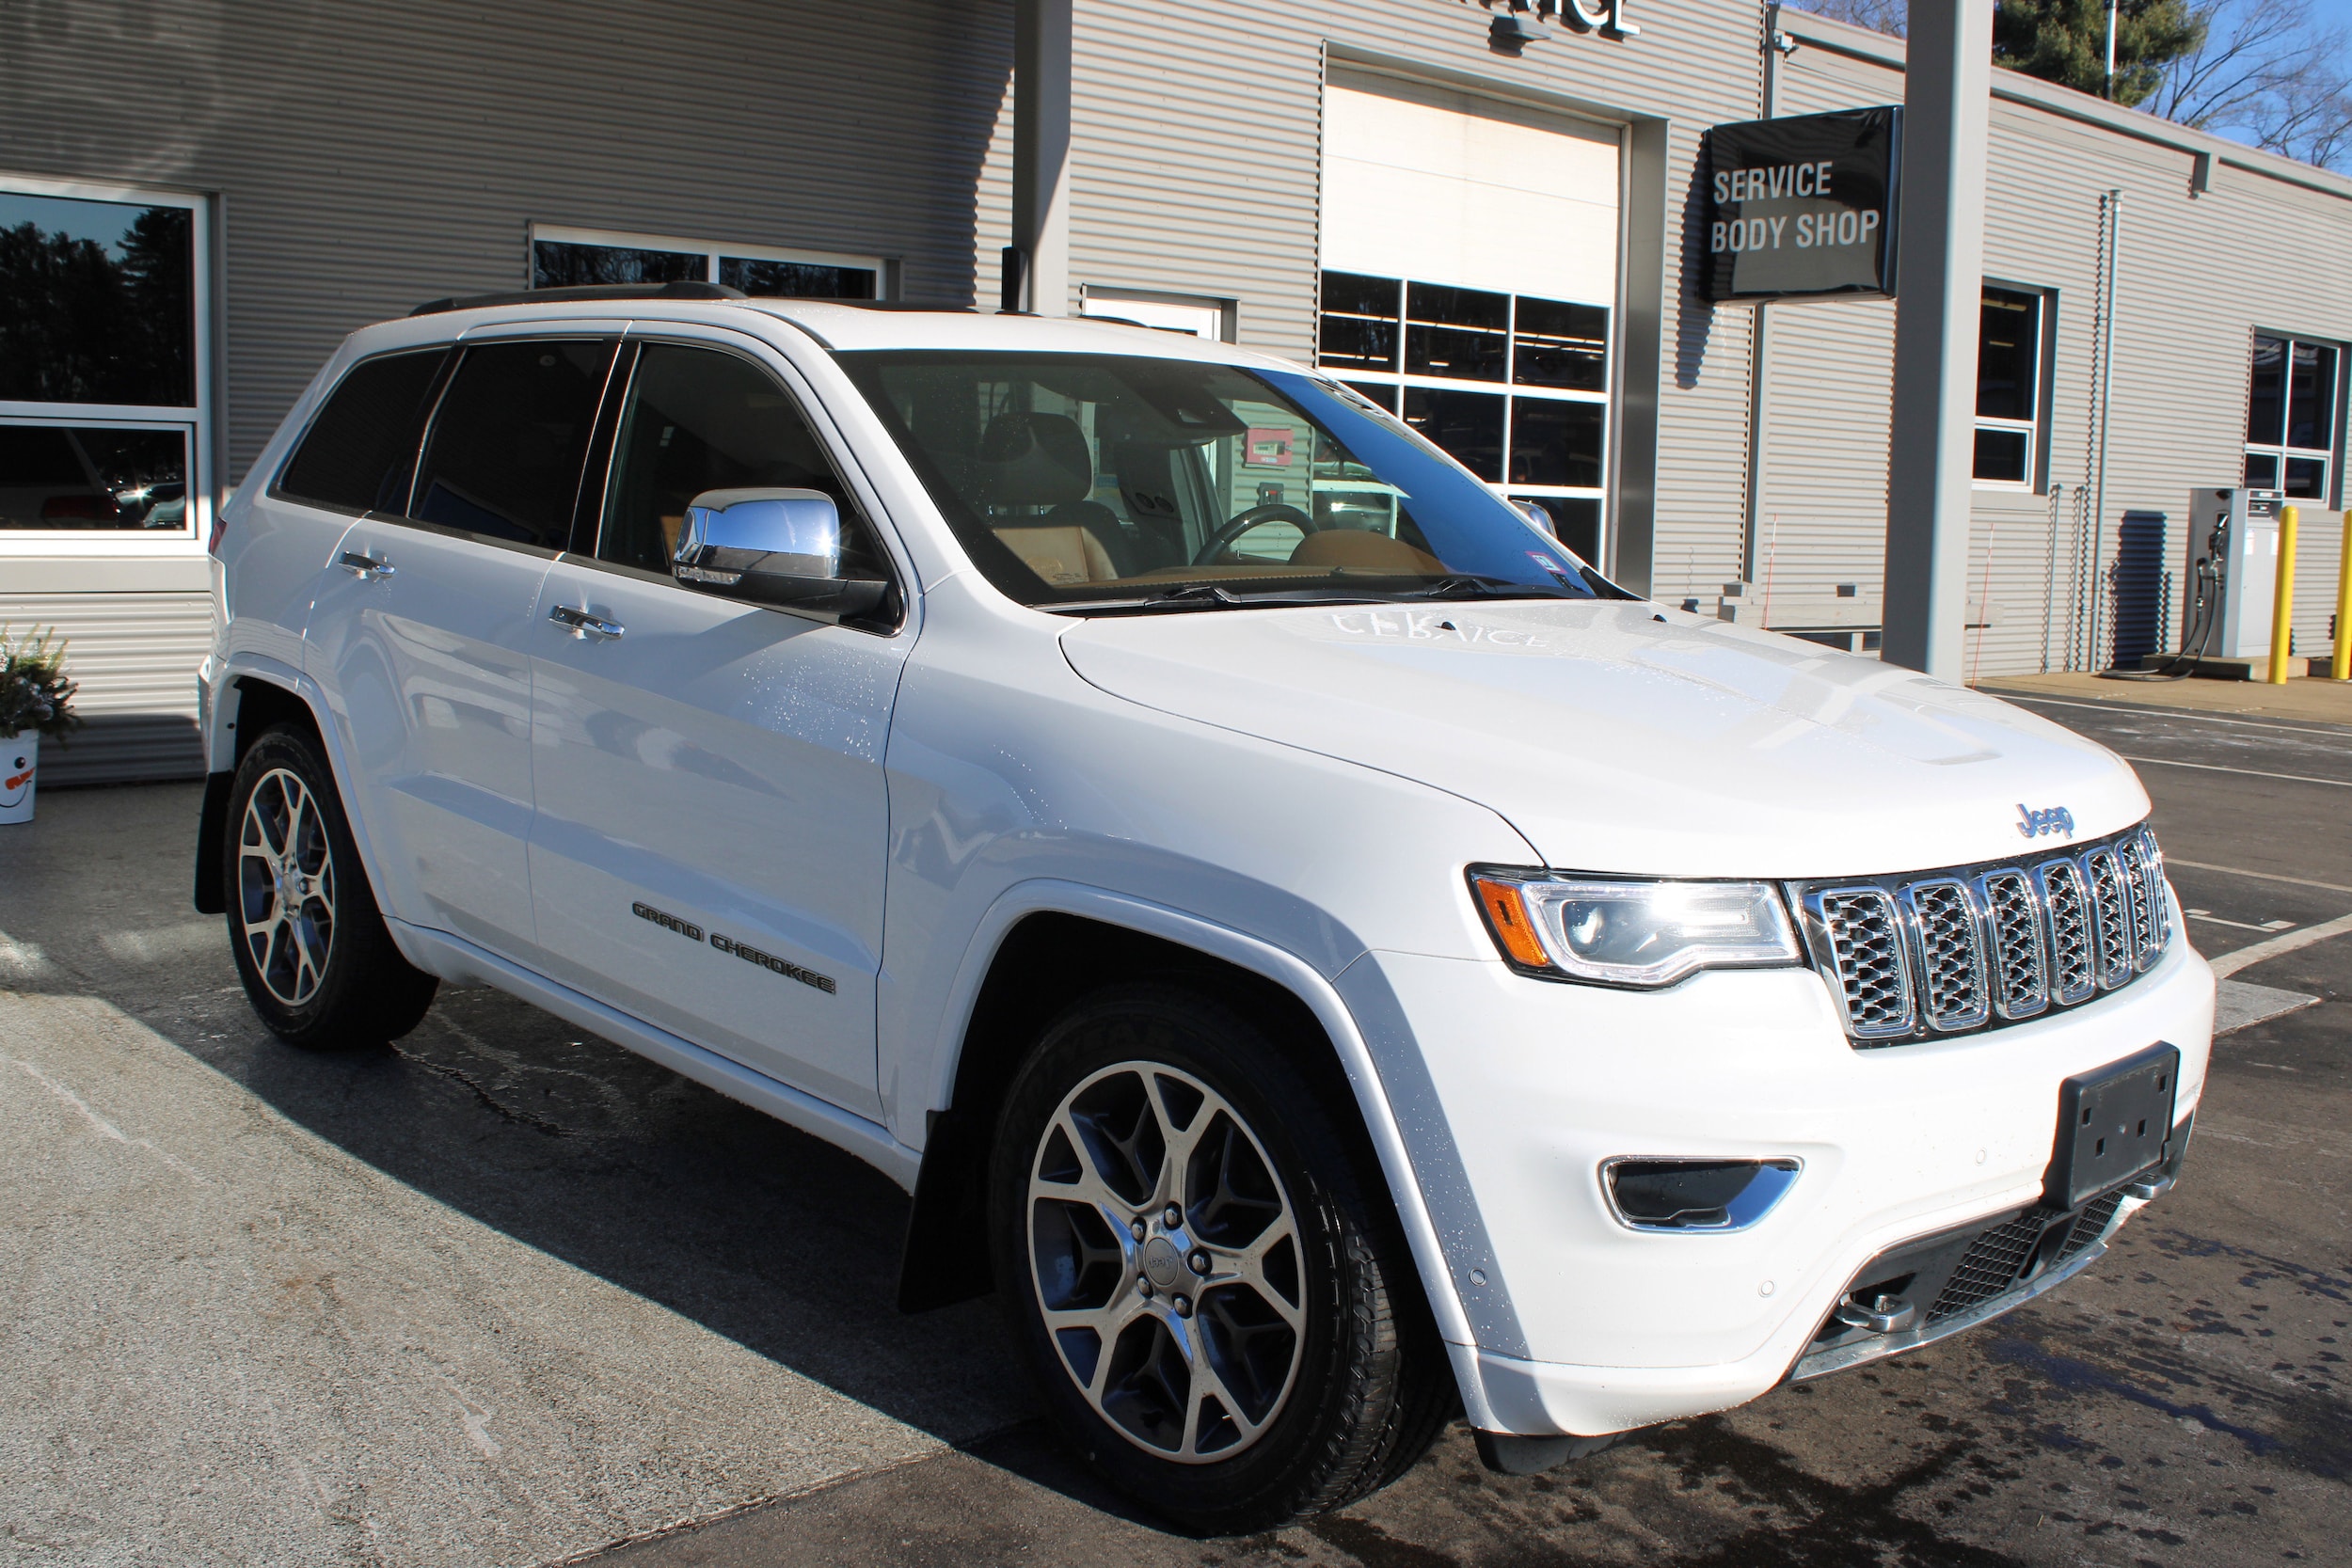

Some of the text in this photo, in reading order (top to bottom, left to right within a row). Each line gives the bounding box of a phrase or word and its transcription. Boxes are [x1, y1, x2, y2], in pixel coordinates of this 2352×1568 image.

[1713, 161, 1833, 204] SERVICE
[1711, 209, 1880, 254] BODY SHOP
[2015, 803, 2074, 839] Jeep
[632, 901, 836, 995] GRAND CHEROKEE
